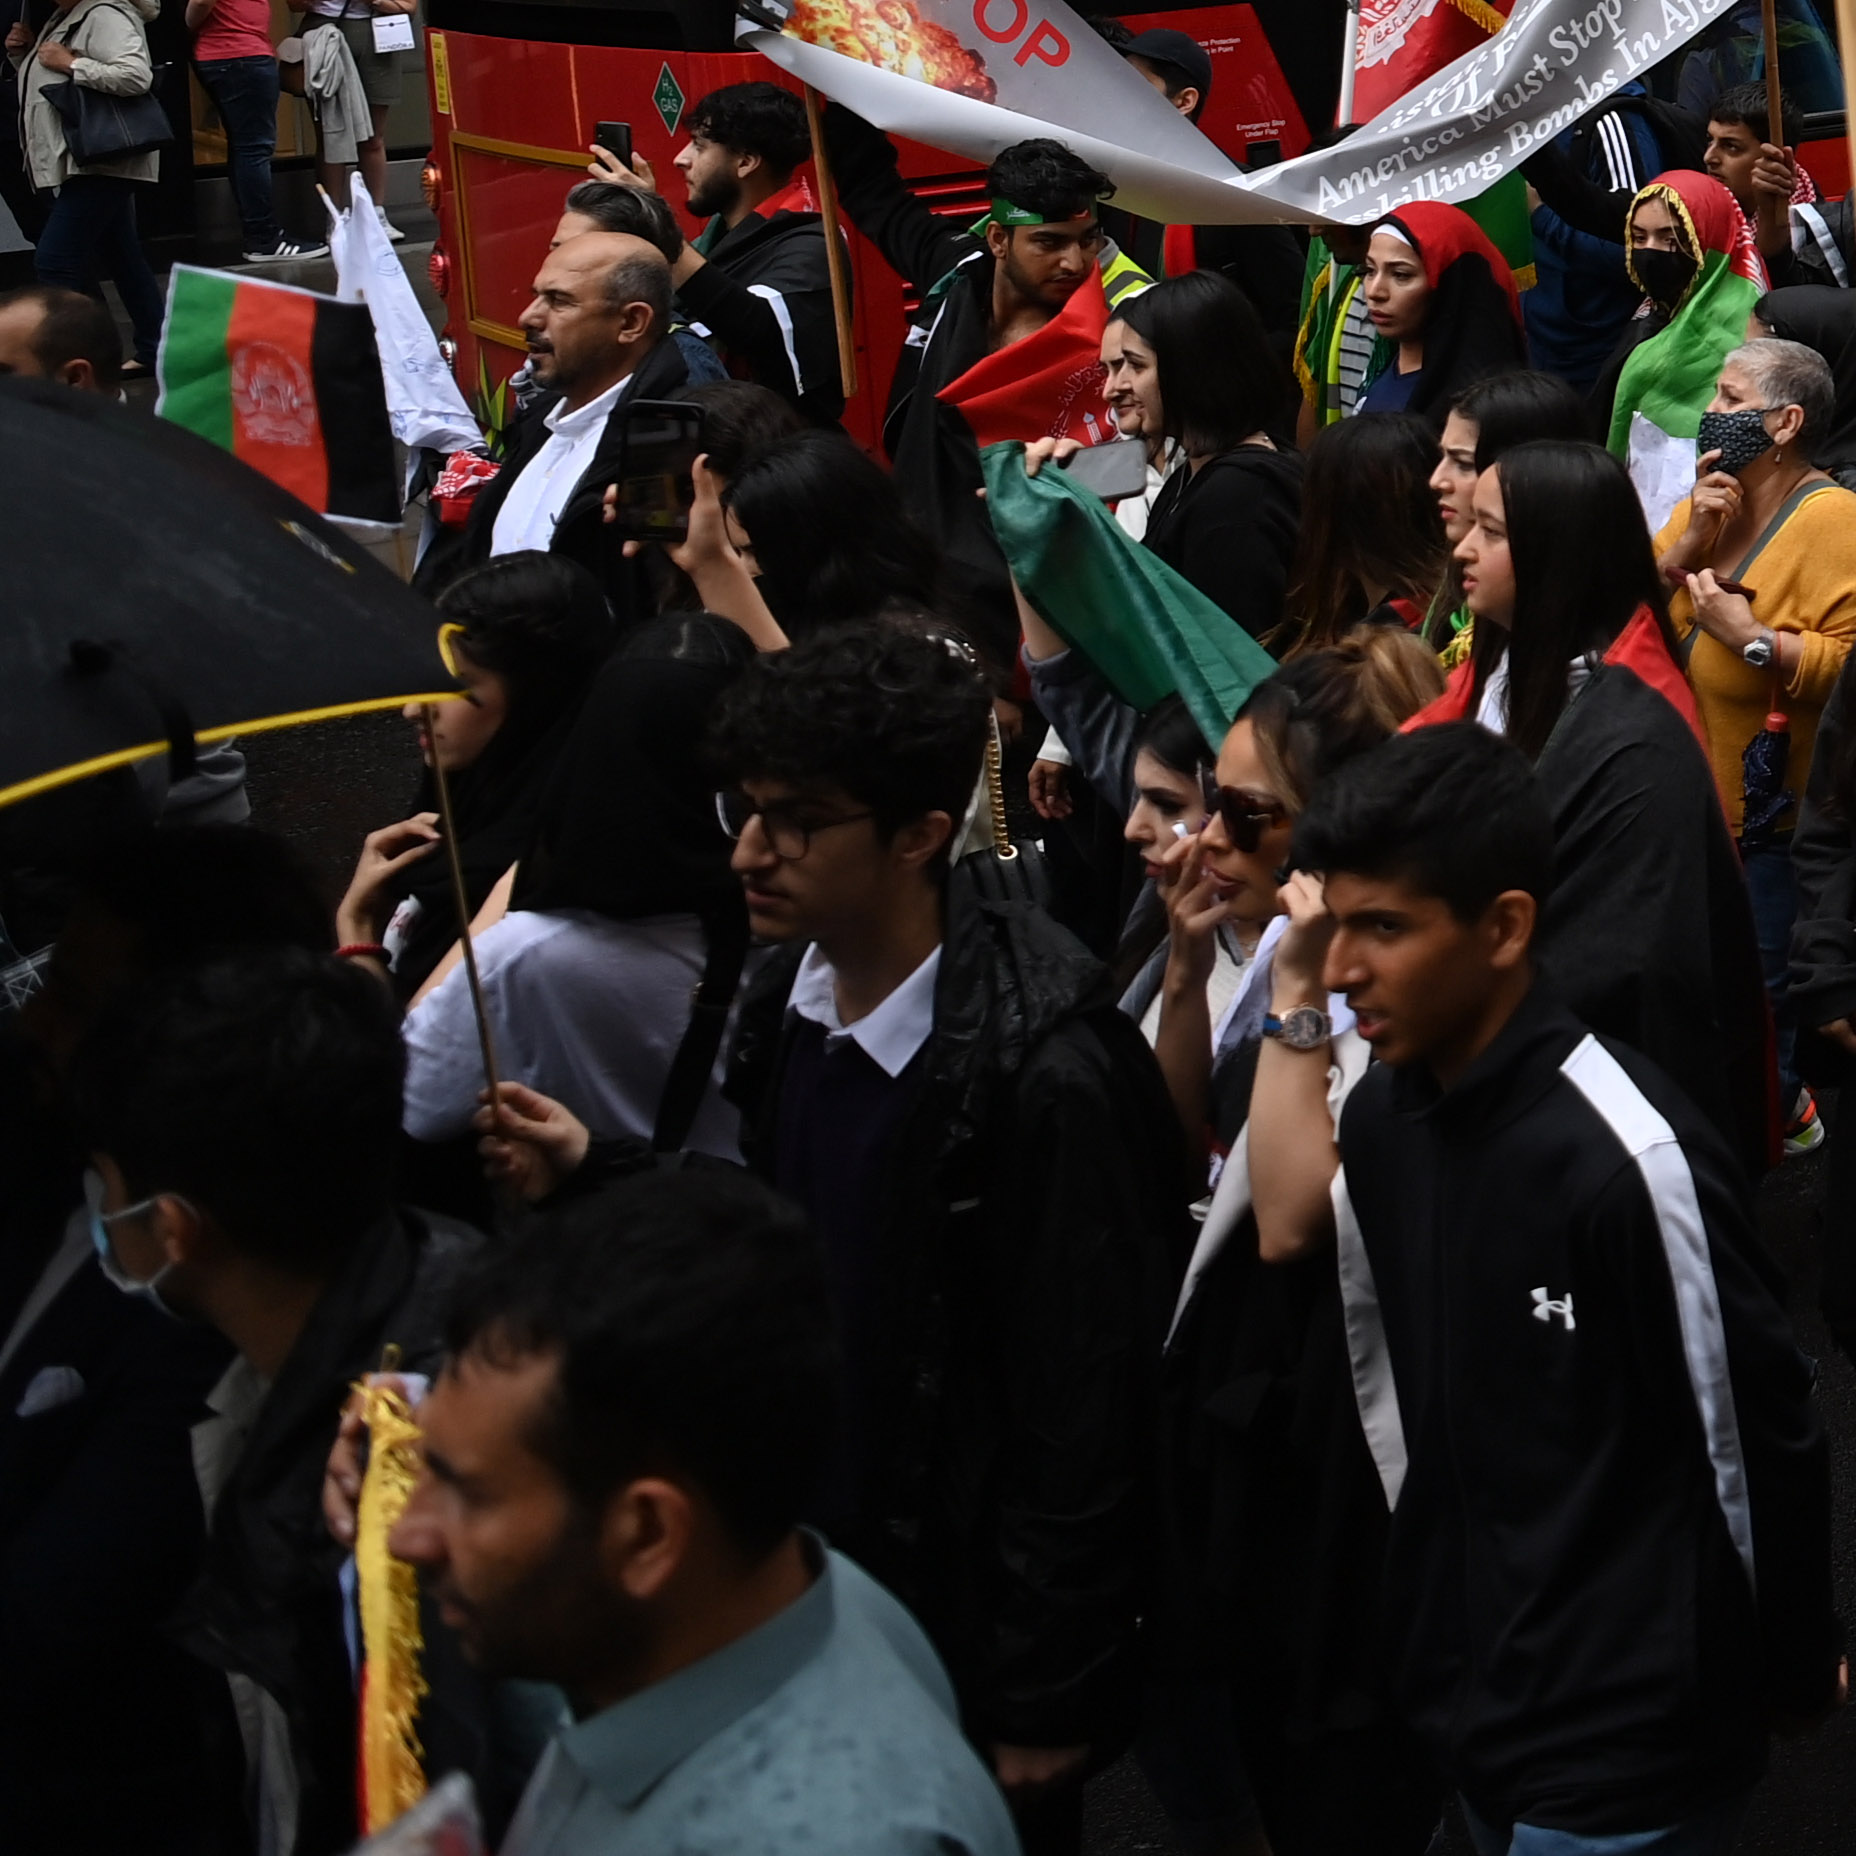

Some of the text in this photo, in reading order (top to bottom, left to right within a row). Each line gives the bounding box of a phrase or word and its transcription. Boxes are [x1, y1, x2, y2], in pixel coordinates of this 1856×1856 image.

[660, 96, 678, 114] GAS
[1317, 126, 1464, 214] America
[1471, 54, 1557, 132] Must
[1505, 68, 1619, 158] Bombs
[1614, 32, 1661, 77] In
